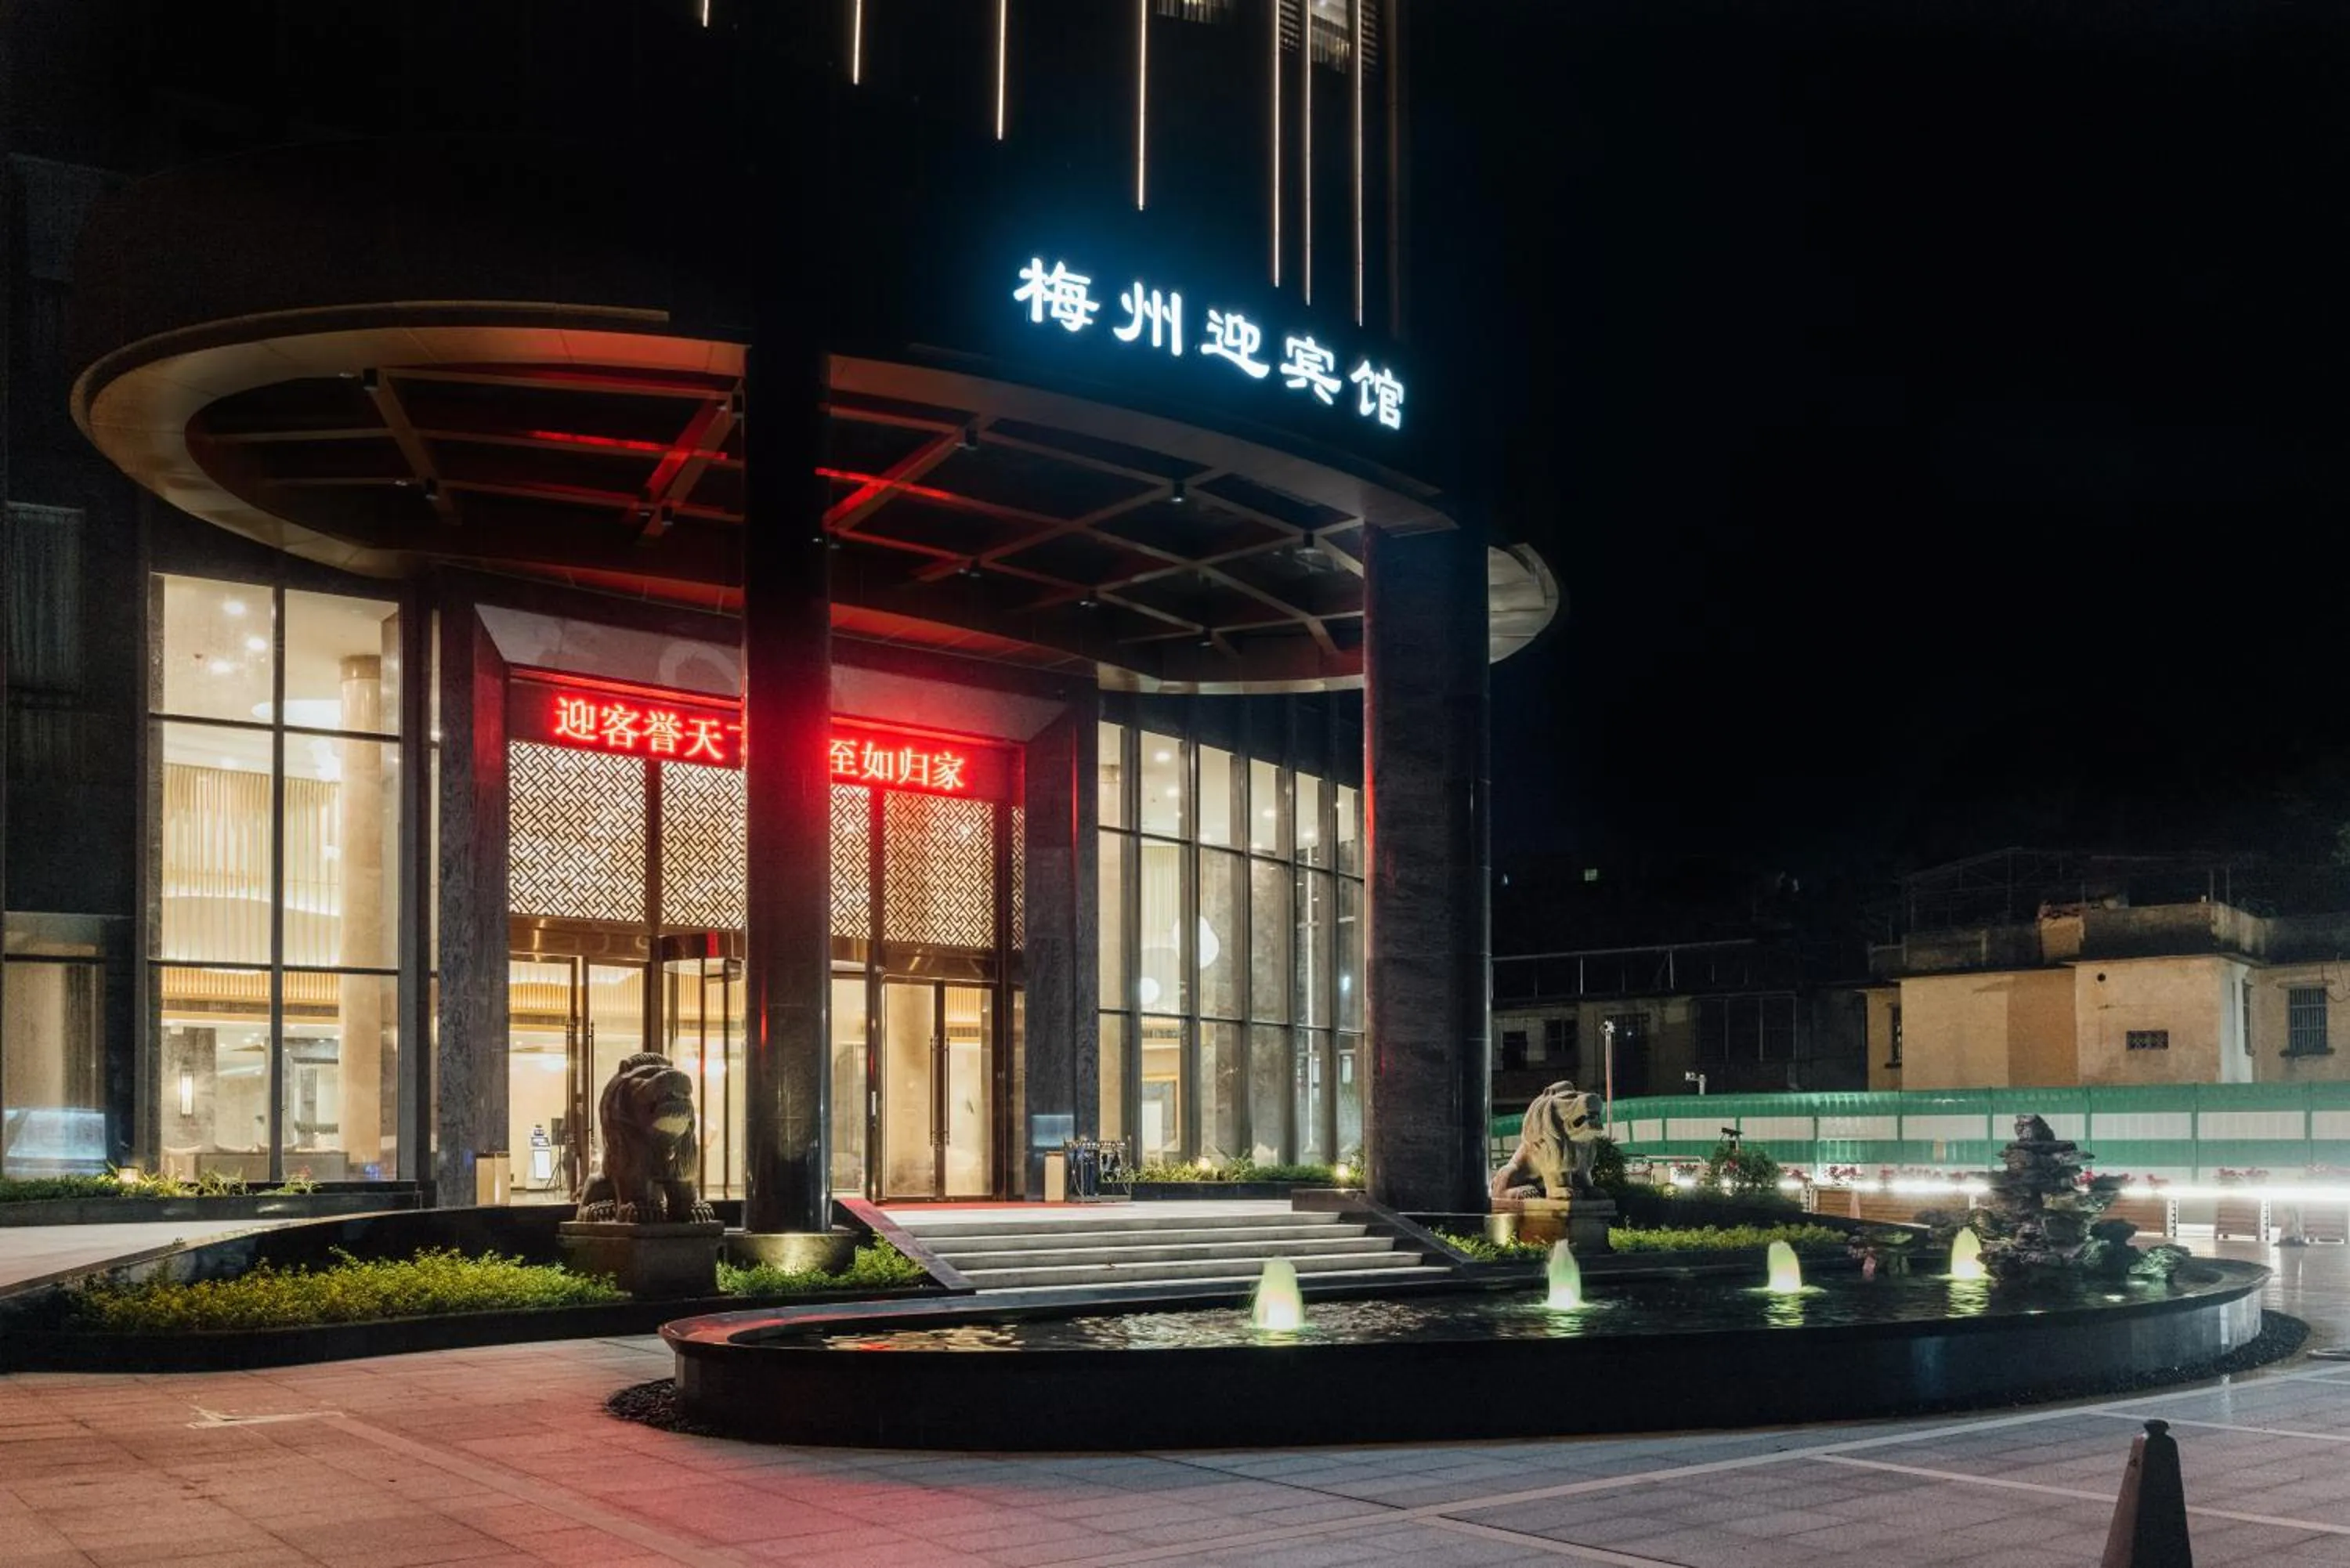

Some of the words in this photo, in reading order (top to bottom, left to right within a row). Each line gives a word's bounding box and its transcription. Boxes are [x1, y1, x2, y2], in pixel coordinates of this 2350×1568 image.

[1014, 258, 1405, 430] 梅州迎宾馆
[555, 695, 743, 760] 迎客誉天
